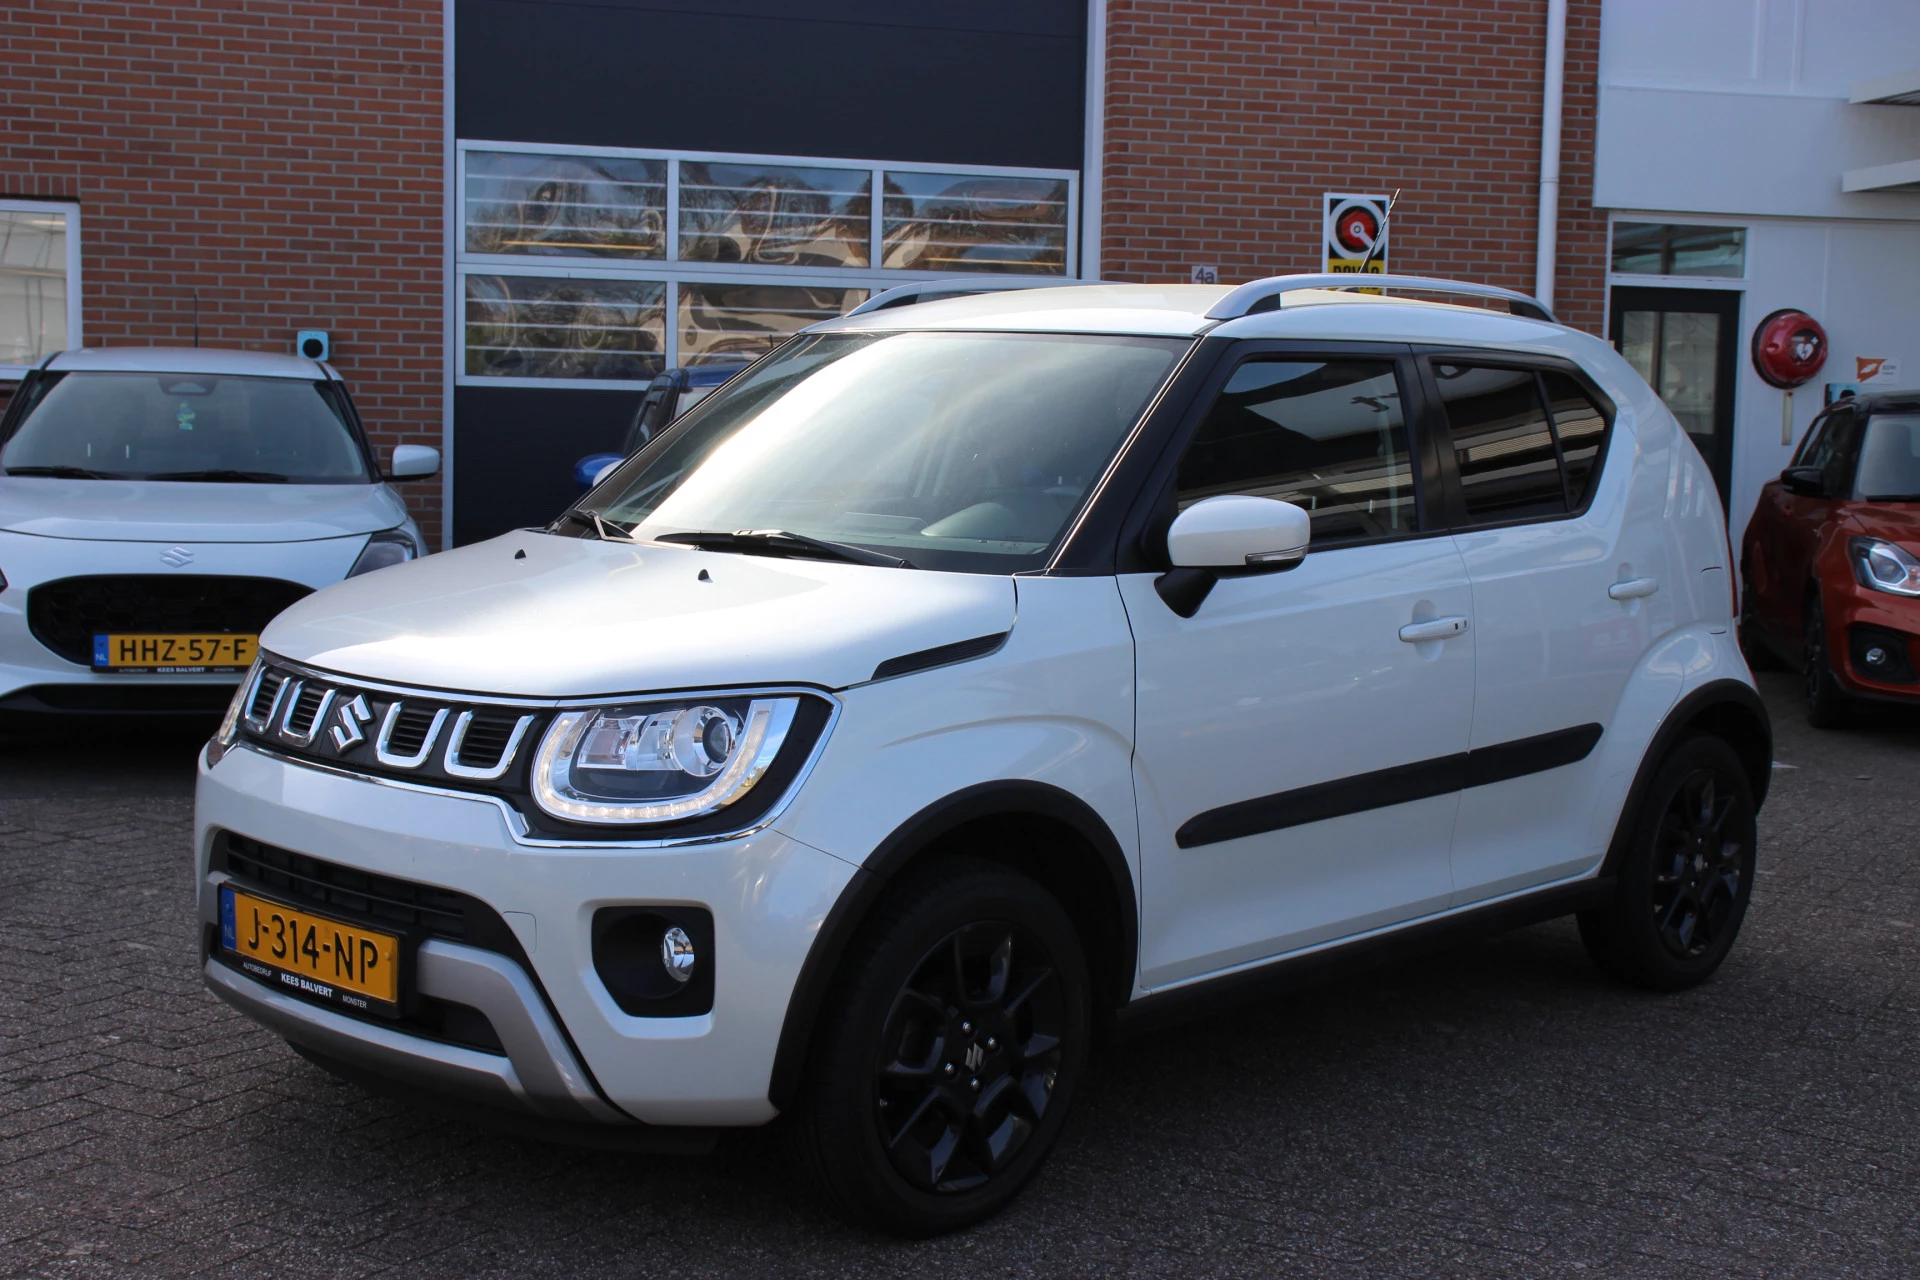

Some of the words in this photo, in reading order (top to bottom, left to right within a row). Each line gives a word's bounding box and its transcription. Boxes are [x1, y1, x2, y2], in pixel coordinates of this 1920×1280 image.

[1195, 267, 1215, 284] 4a
[95, 653, 107, 661] NL
[119, 639, 248, 662] HHZ-57-F
[248, 907, 379, 984] J-314-NP
[281, 972, 300, 987] KEES
[300, 979, 333, 998] BALVERT
[342, 994, 367, 1009] MONSTER
